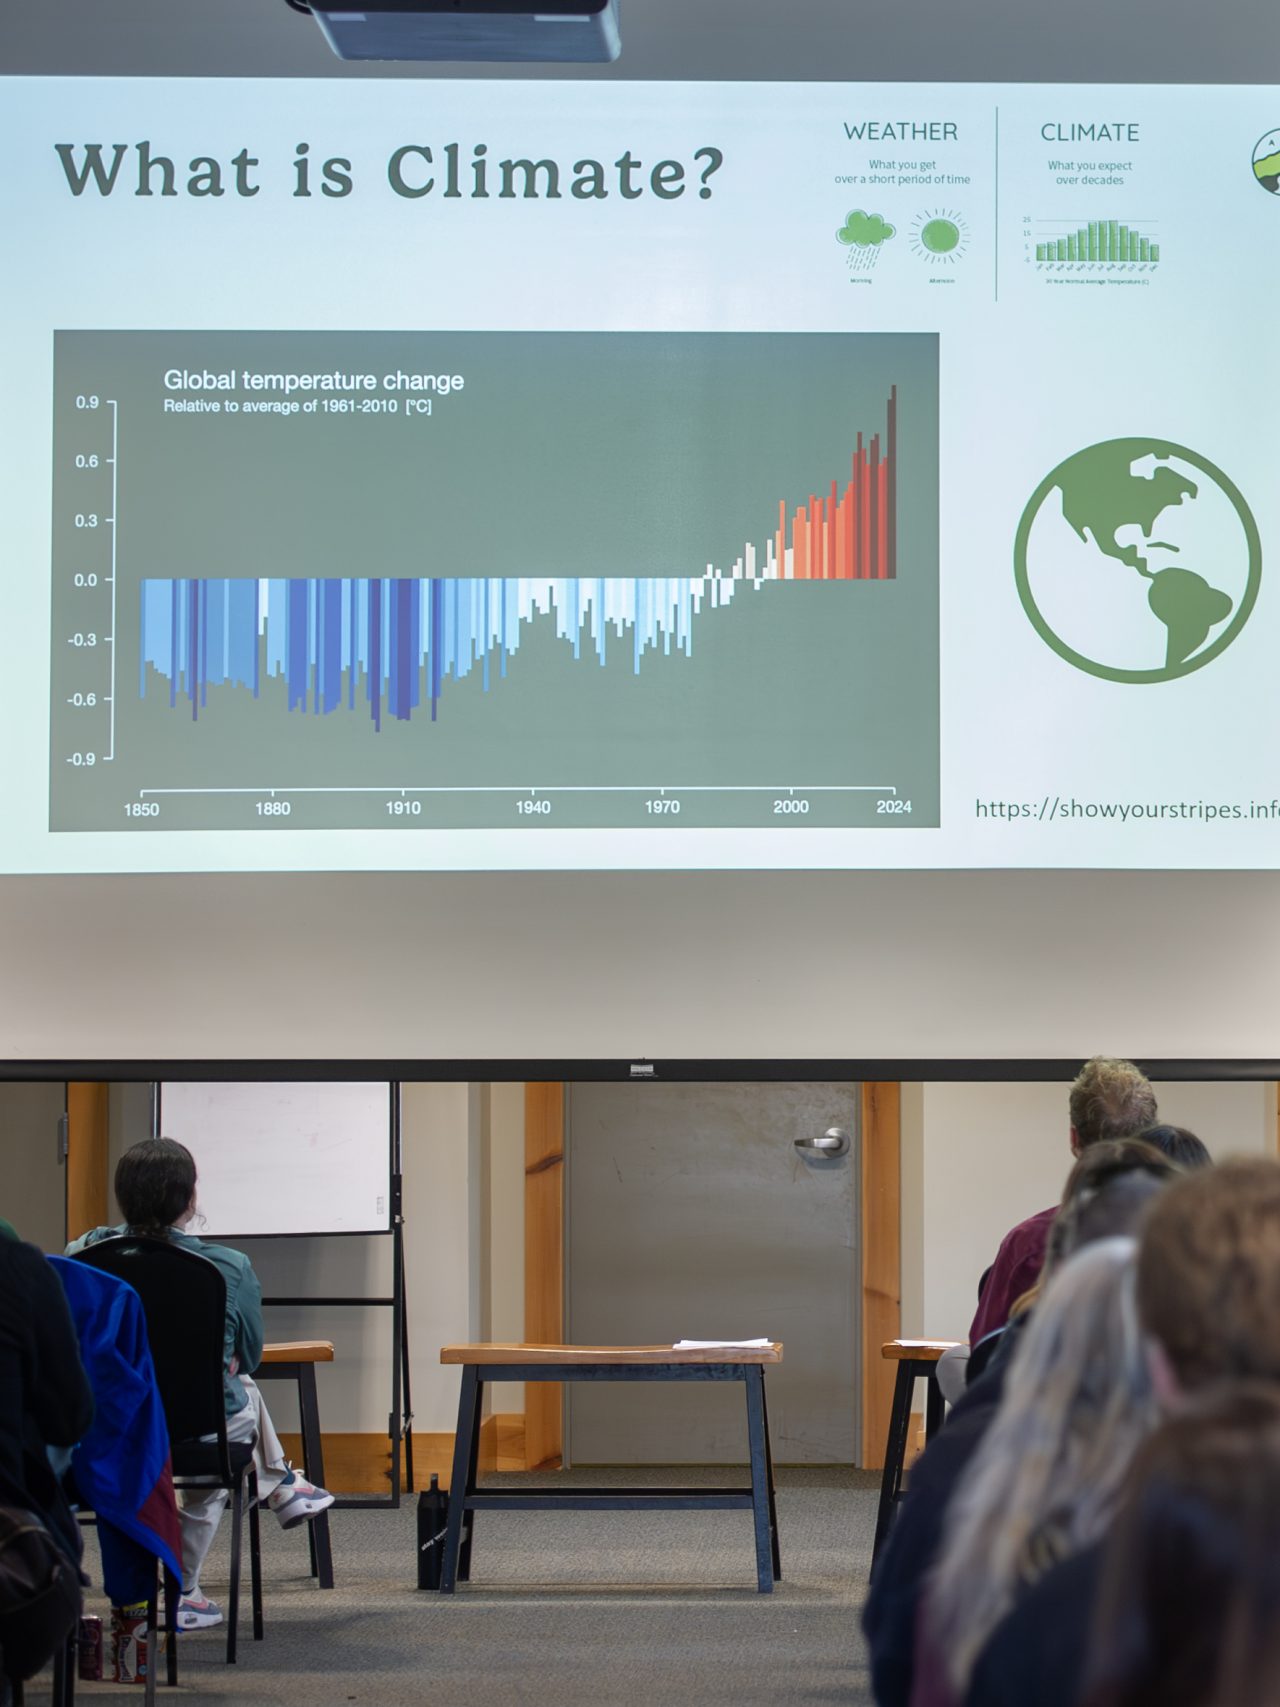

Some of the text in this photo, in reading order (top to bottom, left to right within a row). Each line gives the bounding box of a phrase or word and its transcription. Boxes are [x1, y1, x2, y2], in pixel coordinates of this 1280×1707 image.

[843, 121, 959, 141] WEATHER
[1040, 122, 1140, 142] CLIMATE
[54, 140, 724, 200] What is Climate?
[868, 159, 937, 173] What you get
[1047, 160, 1133, 174] What you expect
[834, 173, 971, 187] over a short period of time
[1056, 174, 1125, 185] over decades
[164, 369, 465, 395] Global temperature change
[75, 395, 100, 409] 0.9
[163, 398, 433, 416] Relative to average of 1961-2010 [°C]
[75, 454, 99, 468] 0.6
[74, 514, 98, 528] 0.3
[74, 573, 98, 587] 0.0
[67, 633, 97, 647] -0.3
[66, 692, 97, 706] -0.6
[66, 752, 96, 766] -0.9
[124, 799, 912, 817] 1850 1880 1910 1940 1970 2000 2024
